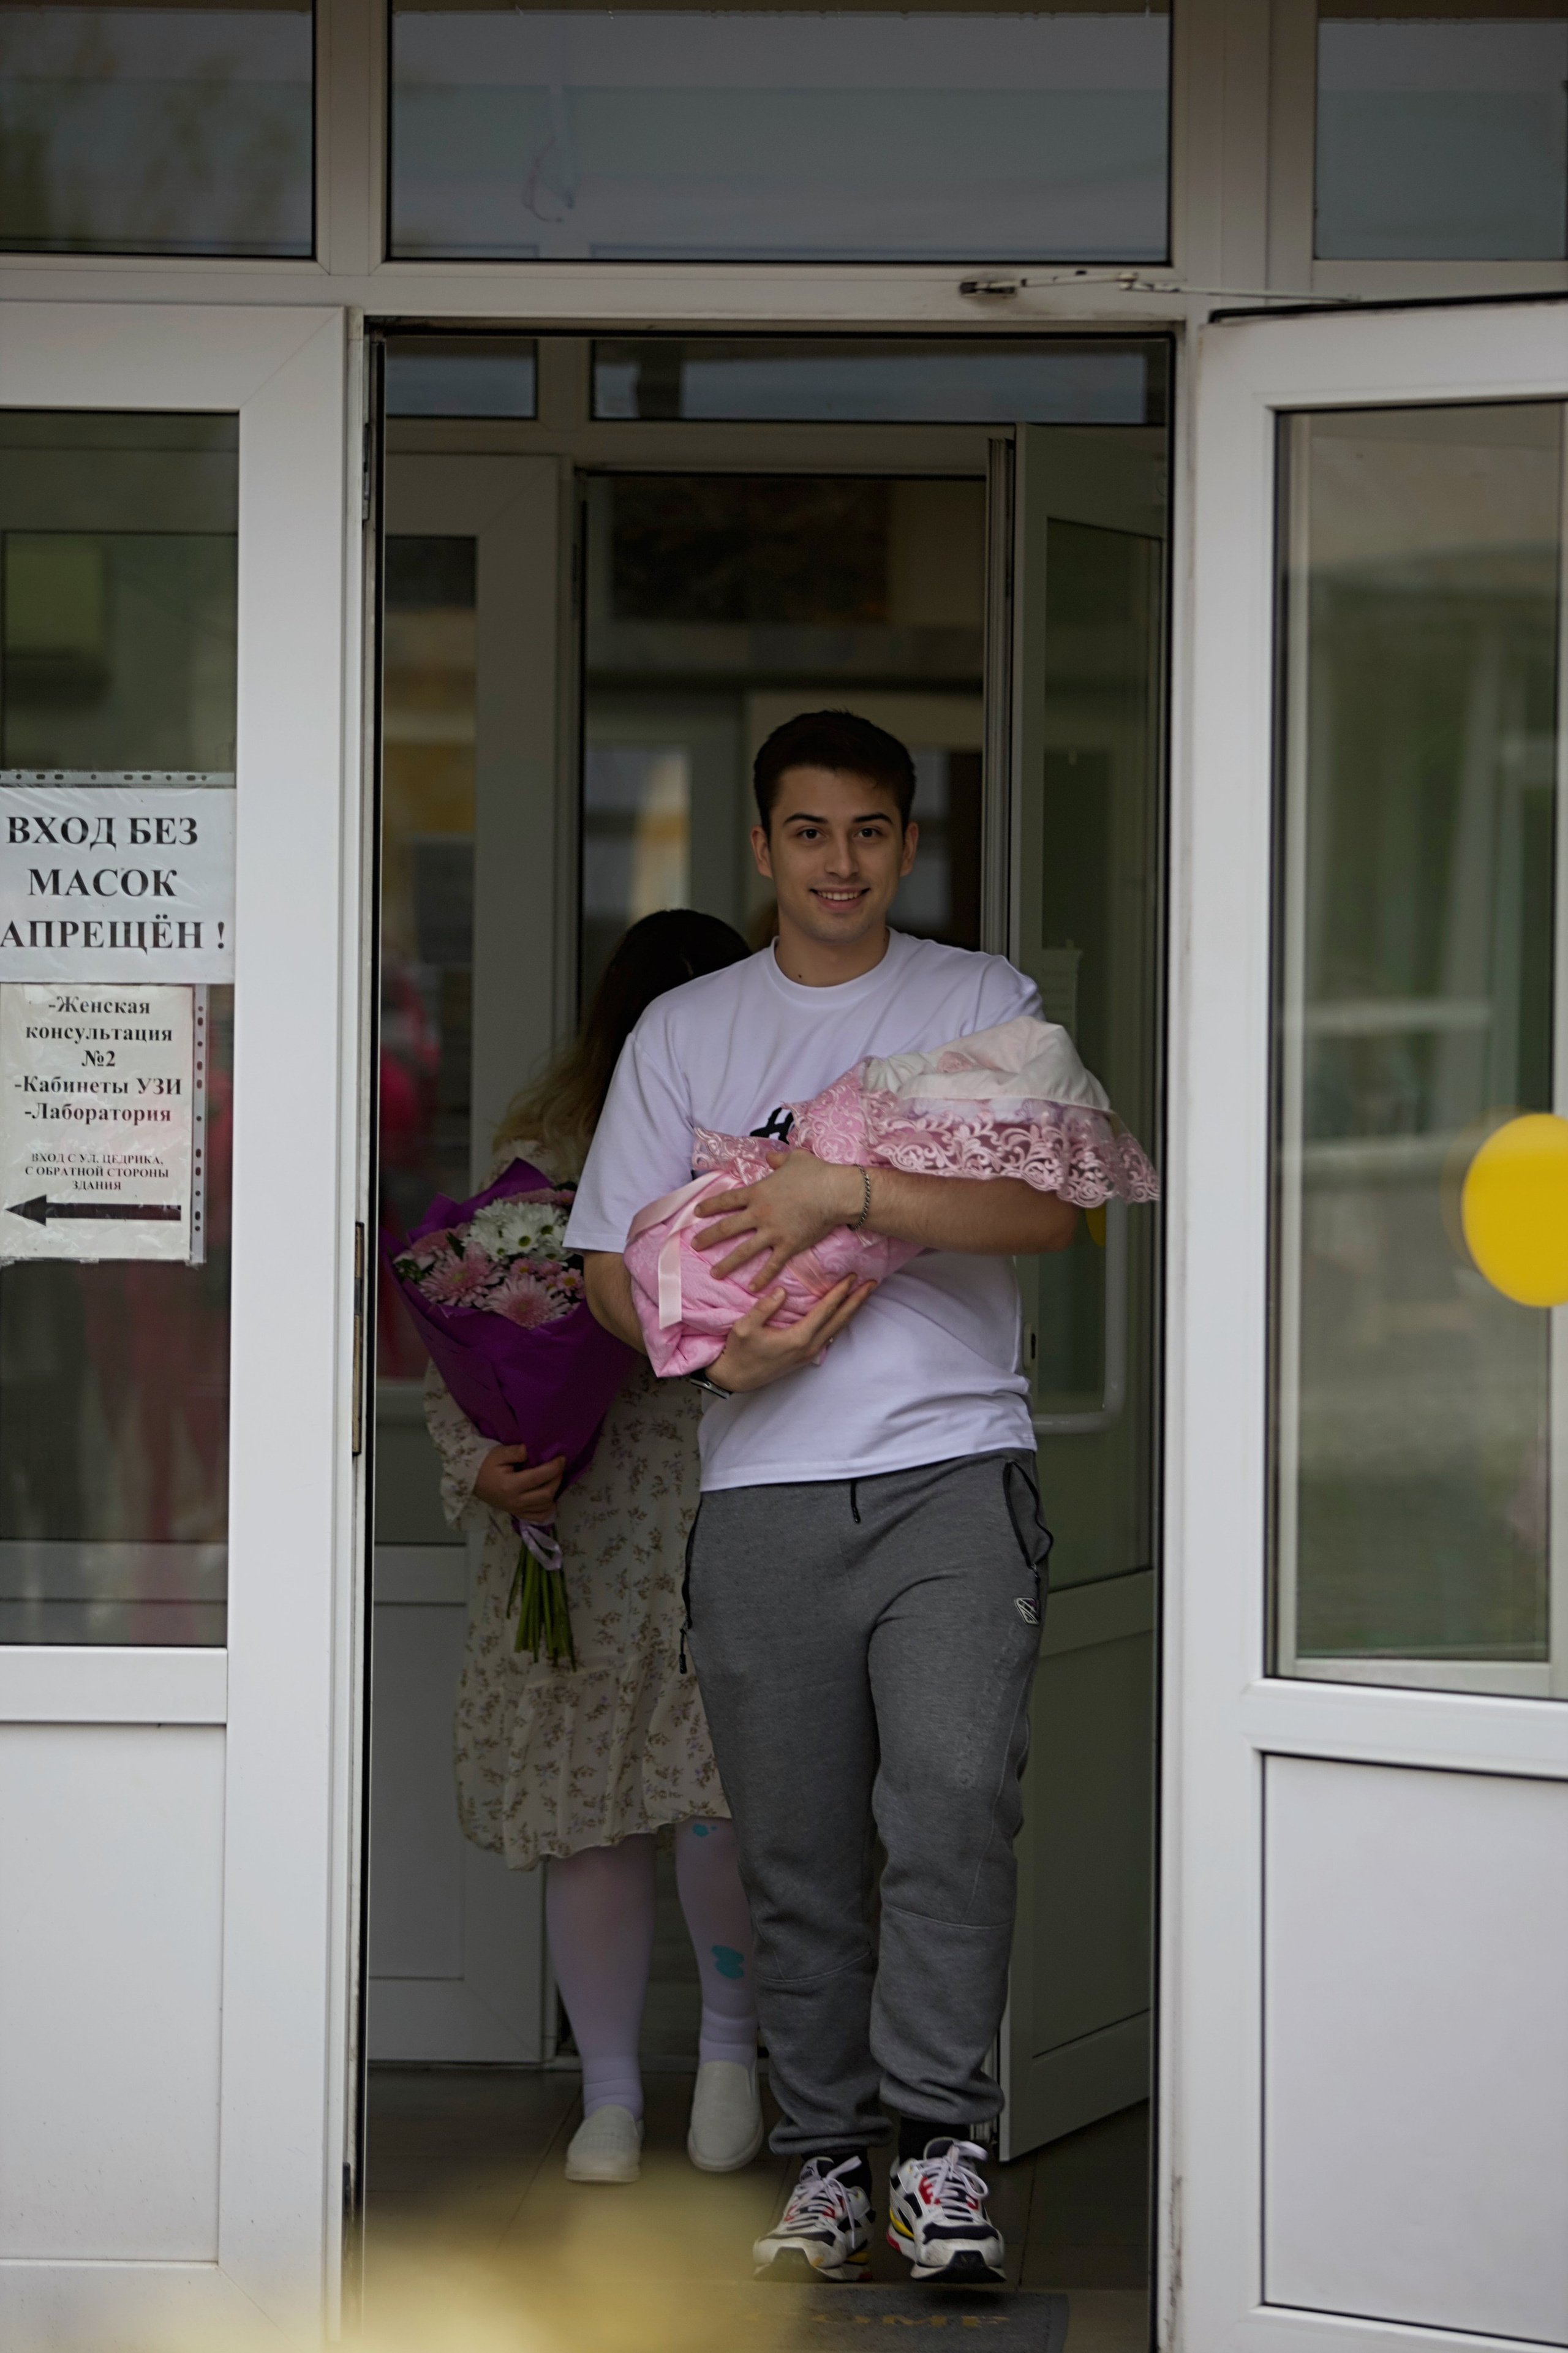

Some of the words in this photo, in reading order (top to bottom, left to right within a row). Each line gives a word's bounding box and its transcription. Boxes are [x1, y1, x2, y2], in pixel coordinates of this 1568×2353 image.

[6, 817, 117, 852] ВХОД
[127, 817, 198, 845] БЕЗ
[28, 868, 178, 897] МАСОК
[49, 995, 150, 1014] -Женская
[26, 1026, 172, 1044] консультация
[81, 1050, 116, 1067] №2
[14, 1075, 129, 1094] -Кабинеты
[137, 1078, 182, 1095] УЗИ
[24, 1102, 171, 1125] -Лаборатория
[32, 1153, 65, 1164] ВХОД
[25, 1166, 33, 1175] С
[36, 1165, 104, 1176] ОБРАТНОЙ
[107, 1168, 168, 1177] СТОРОНЫ
[73, 1180, 121, 1190] ЗДАНИЯ
